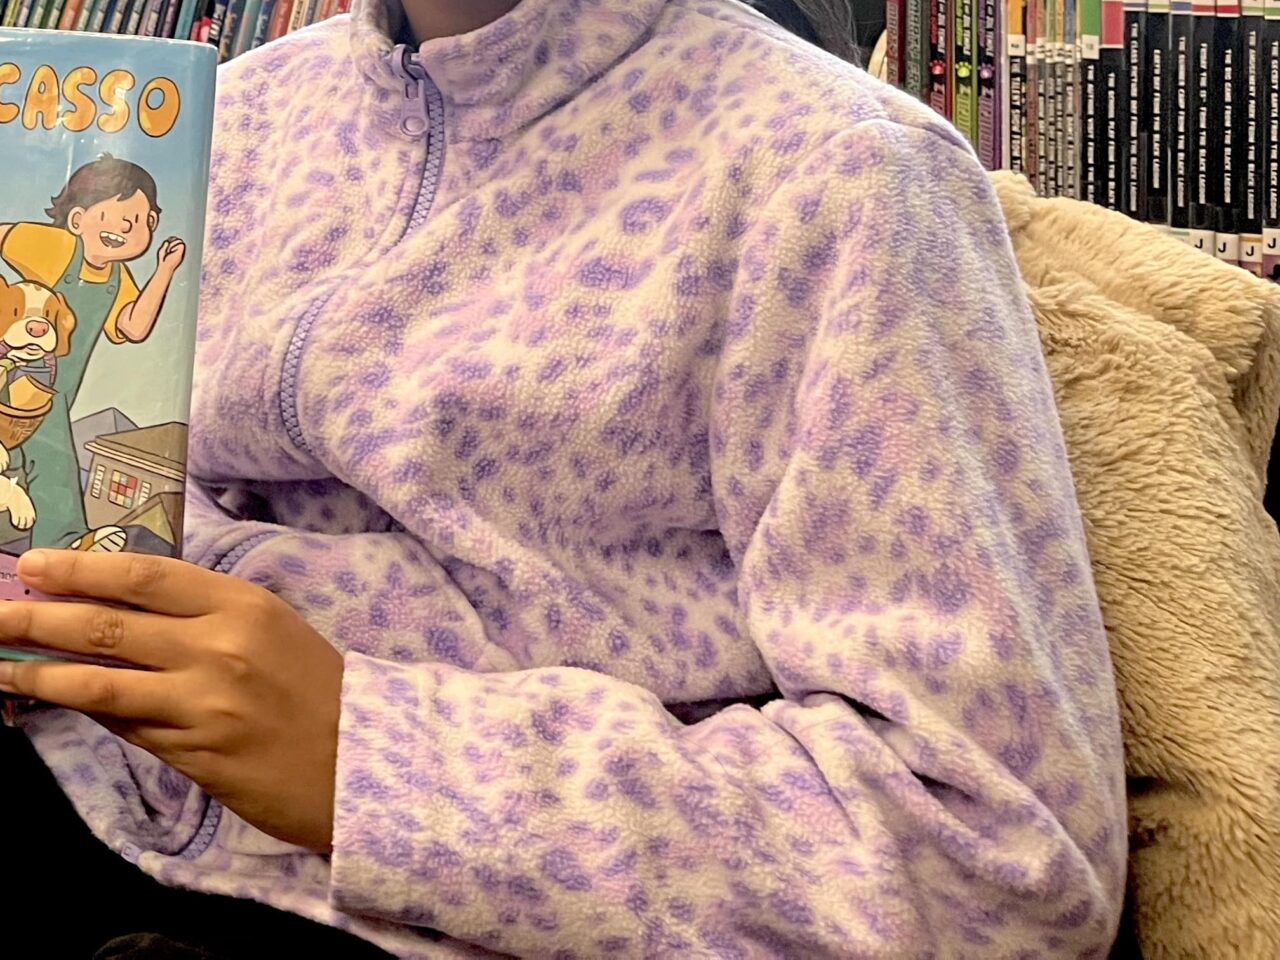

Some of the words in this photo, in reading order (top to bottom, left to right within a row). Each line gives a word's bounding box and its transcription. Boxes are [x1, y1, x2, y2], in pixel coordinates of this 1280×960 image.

[1011, 58, 1021, 74] THE
[1011, 76, 1021, 106] TALENT
[1011, 109, 1021, 132] SHOW
[1011, 134, 1021, 157] FROM
[1194, 238, 1204, 249] J
[1218, 242, 1226, 253] J
[1268, 238, 1276, 248] J
[1246, 246, 1254, 256] J
